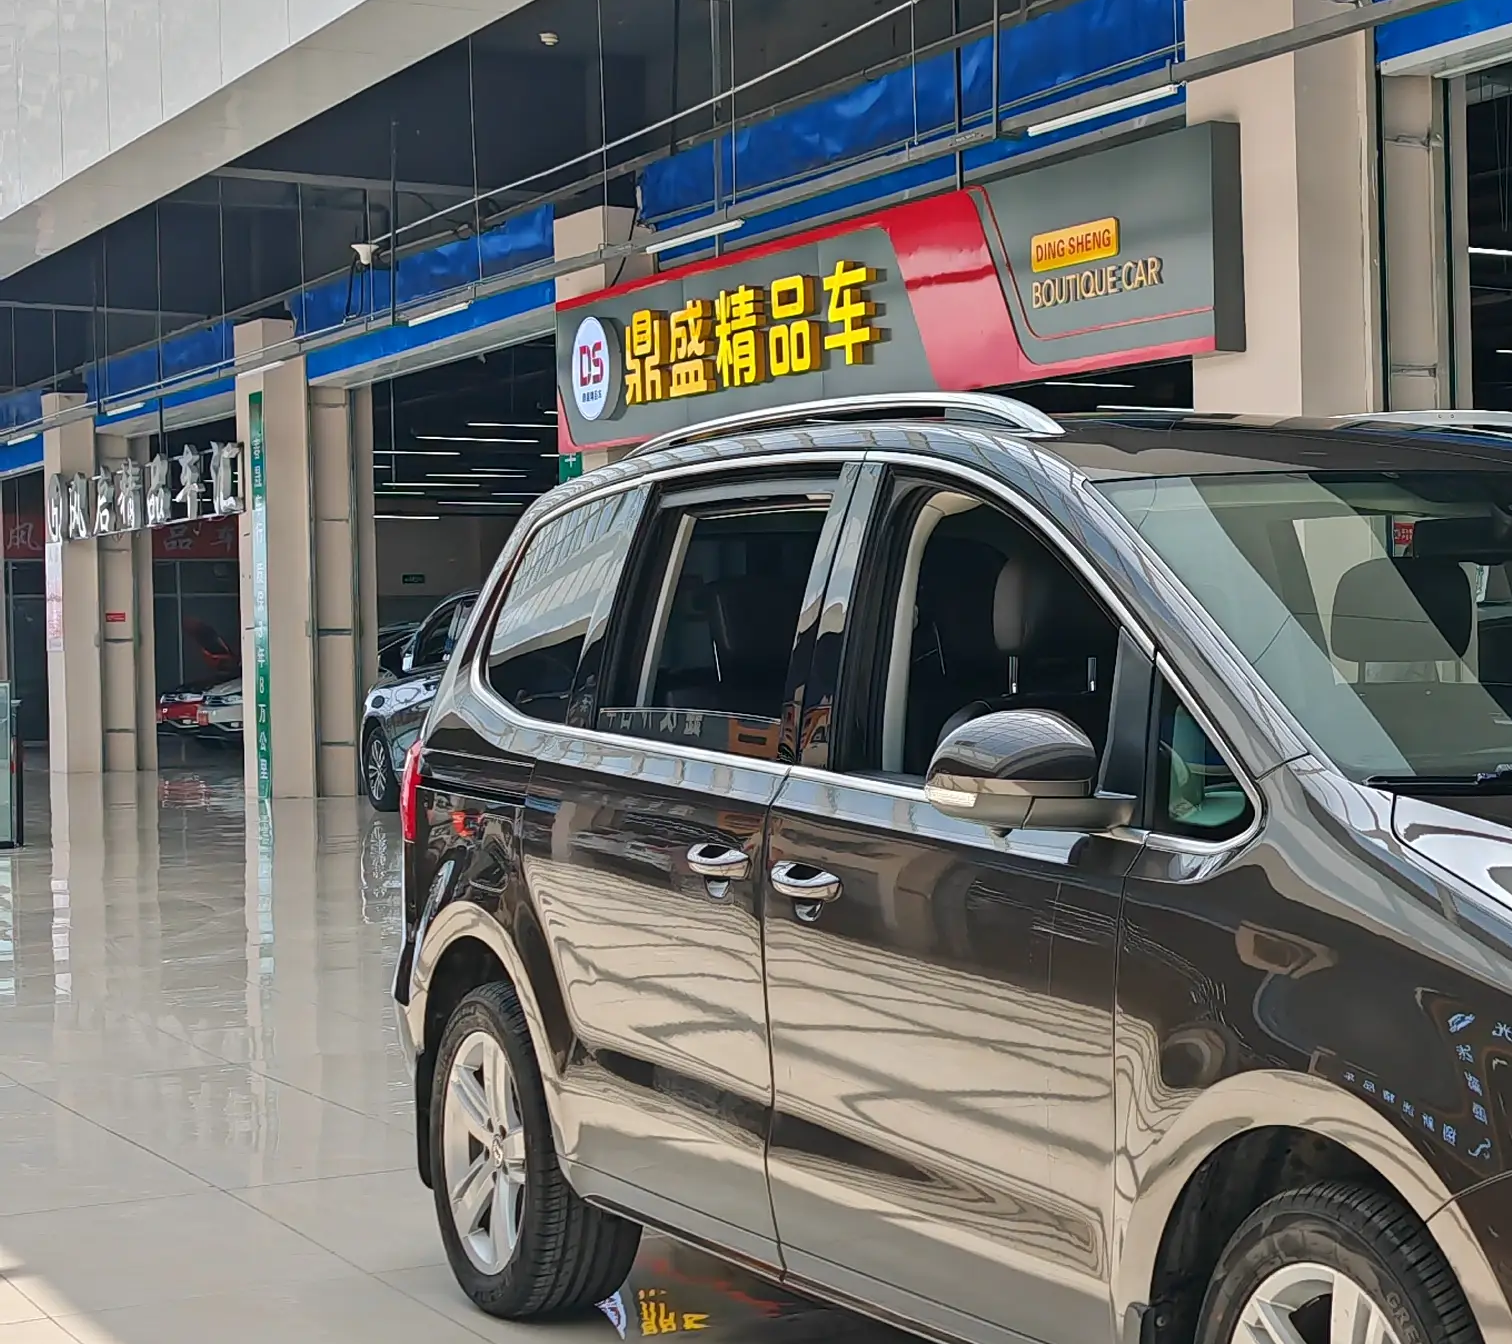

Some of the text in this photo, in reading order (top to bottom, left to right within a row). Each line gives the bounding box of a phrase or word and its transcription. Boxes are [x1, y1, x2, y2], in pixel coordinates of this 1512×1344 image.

[1035, 228, 1111, 263] DING SHENG
[1032, 256, 1162, 309] BOUTIQUE CAR
[624, 259, 881, 406] 鼎盛精品车
[578, 340, 604, 388] DS
